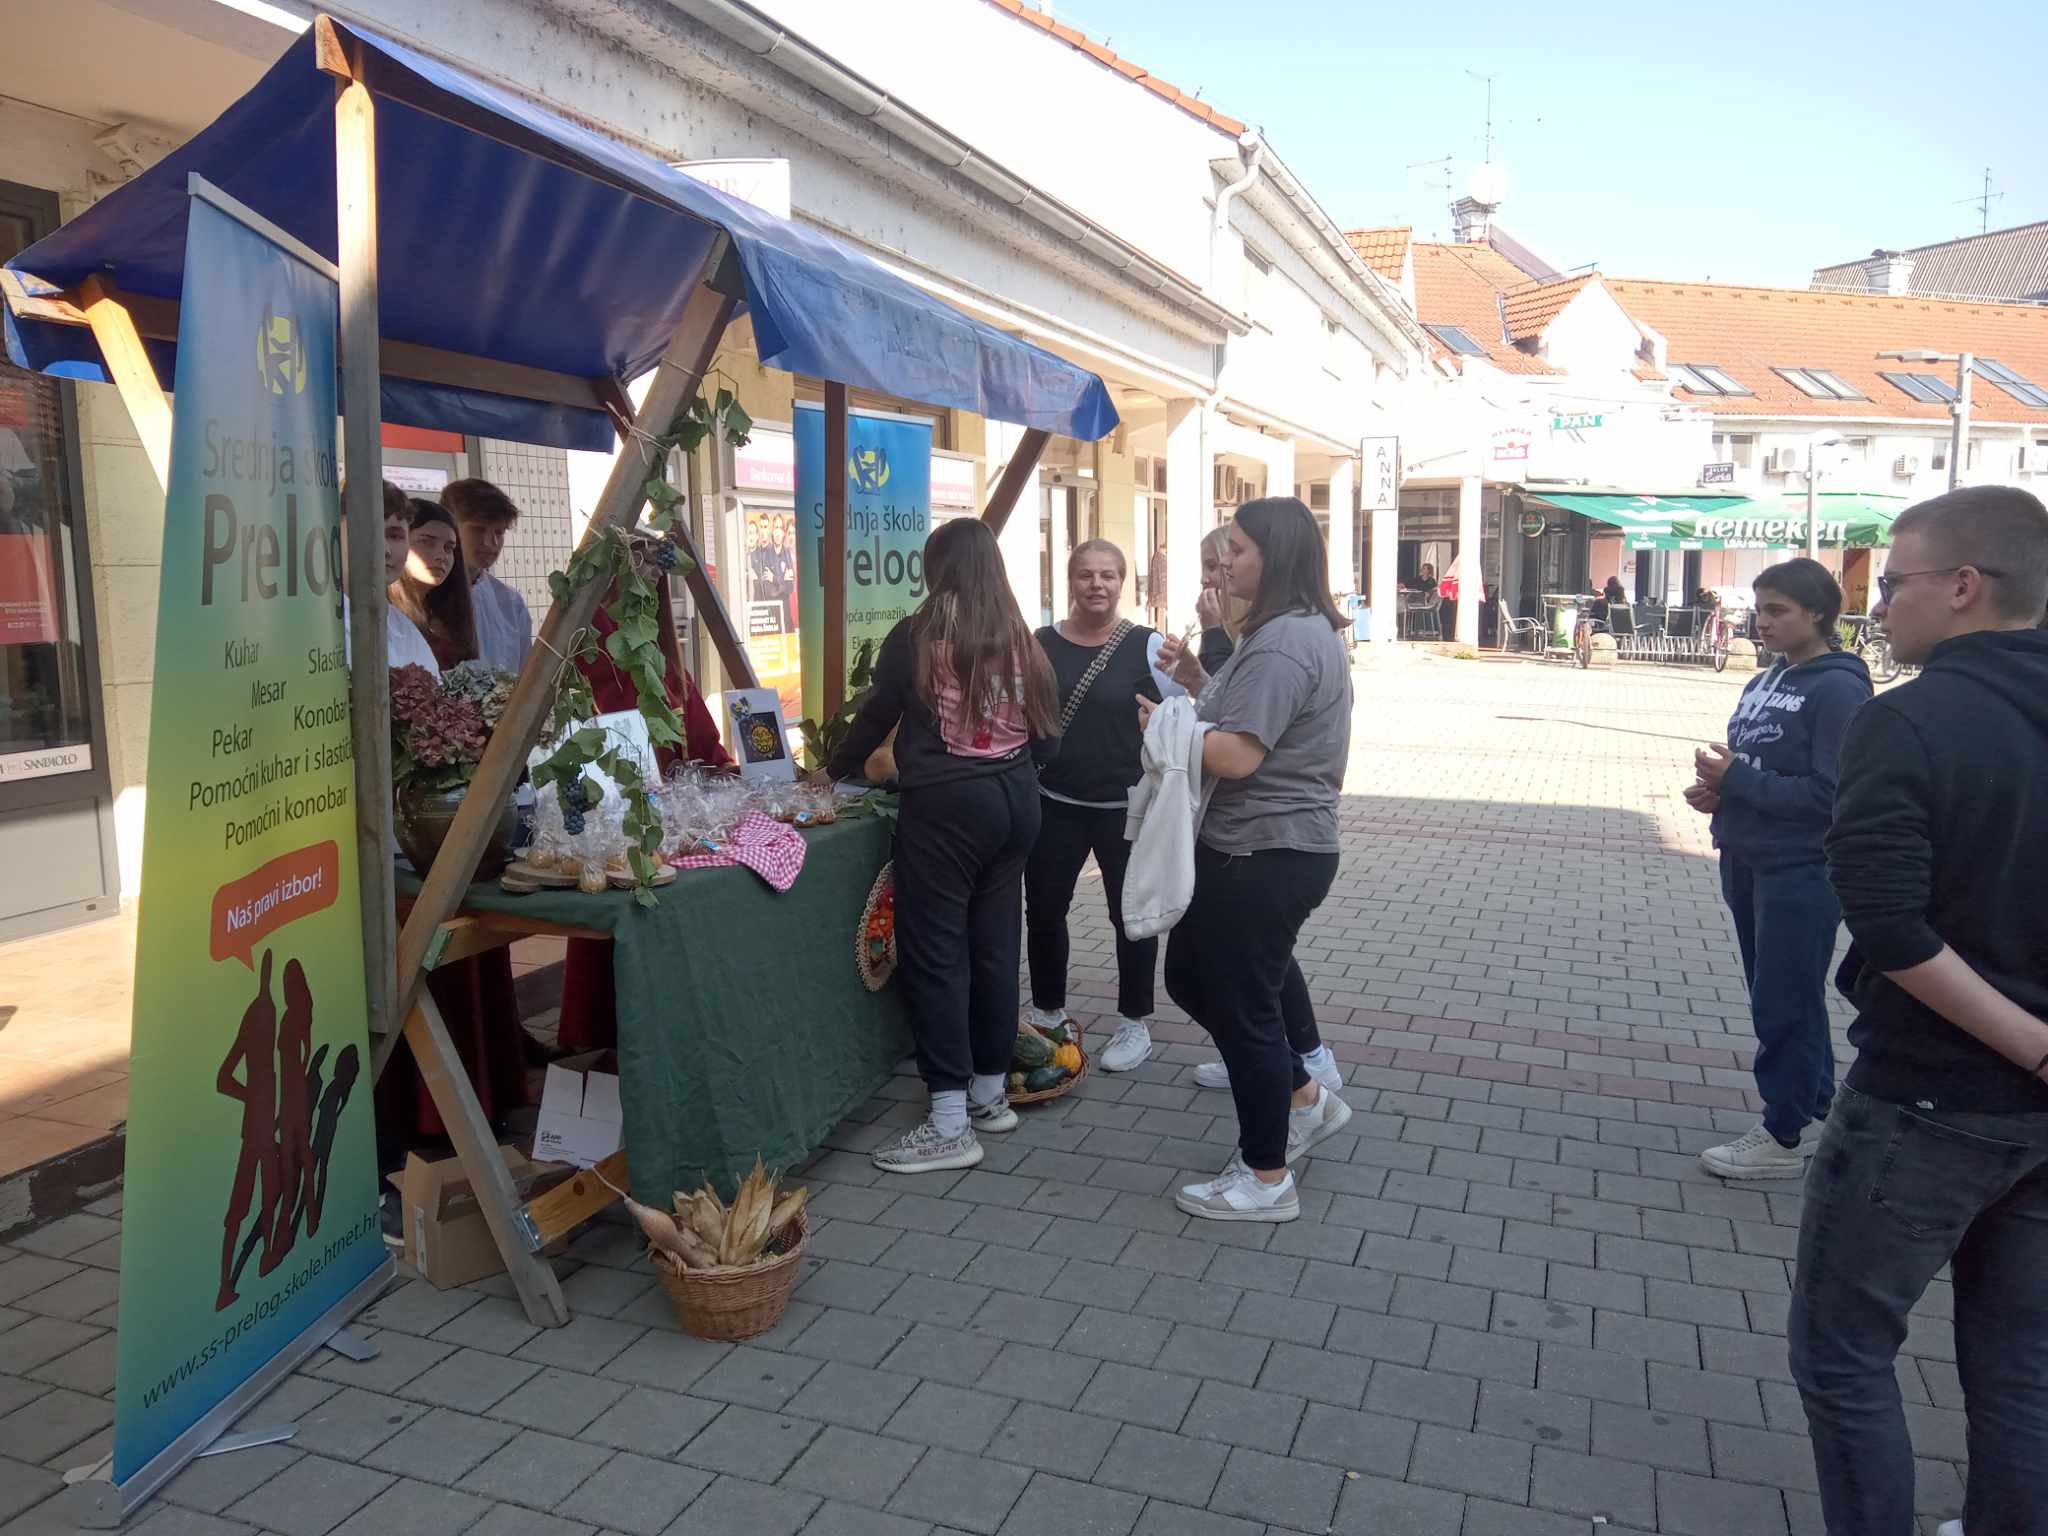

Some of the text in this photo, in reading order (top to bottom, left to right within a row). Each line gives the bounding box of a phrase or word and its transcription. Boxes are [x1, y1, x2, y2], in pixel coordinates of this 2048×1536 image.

[202, 418, 295, 497] Srednja
[1376, 446, 1391, 505] ANNA
[883, 505, 925, 532] škola
[848, 608, 864, 624] pća
[224, 637, 259, 669] Kuhar
[252, 680, 287, 708] Mesar
[212, 724, 253, 757] Pekar
[189, 763, 258, 811] Pomoćni
[261, 754, 300, 787] kuhar
[304, 748, 310, 773] i
[225, 786, 347, 850] Pomoćni konobar
[226, 866, 323, 933] Naš pravi izbor!
[143, 1212, 378, 1409] www.ss-prelog.skole.htnet.hr
